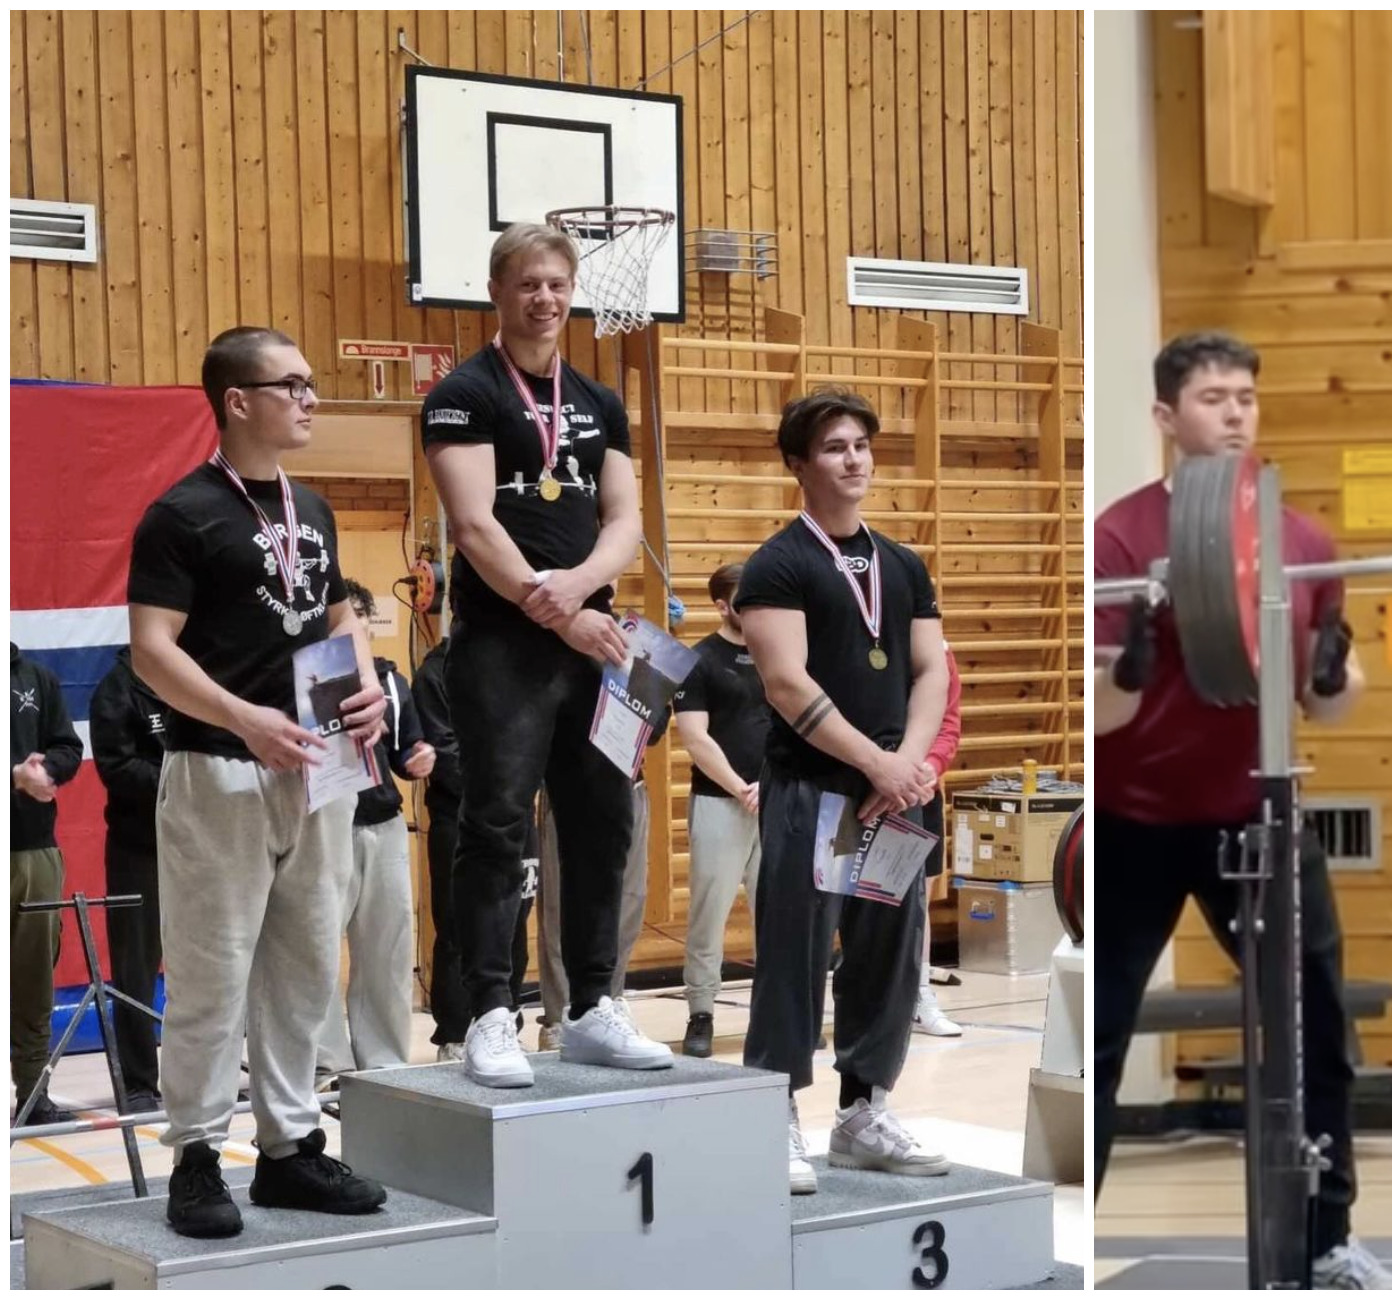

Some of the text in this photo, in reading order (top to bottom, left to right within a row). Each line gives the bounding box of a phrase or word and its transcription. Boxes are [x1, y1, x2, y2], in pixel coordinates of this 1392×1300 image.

[608, 679, 652, 720] DIPLOM
[627, 1152, 655, 1225] 1
[911, 1220, 950, 1289] 3
